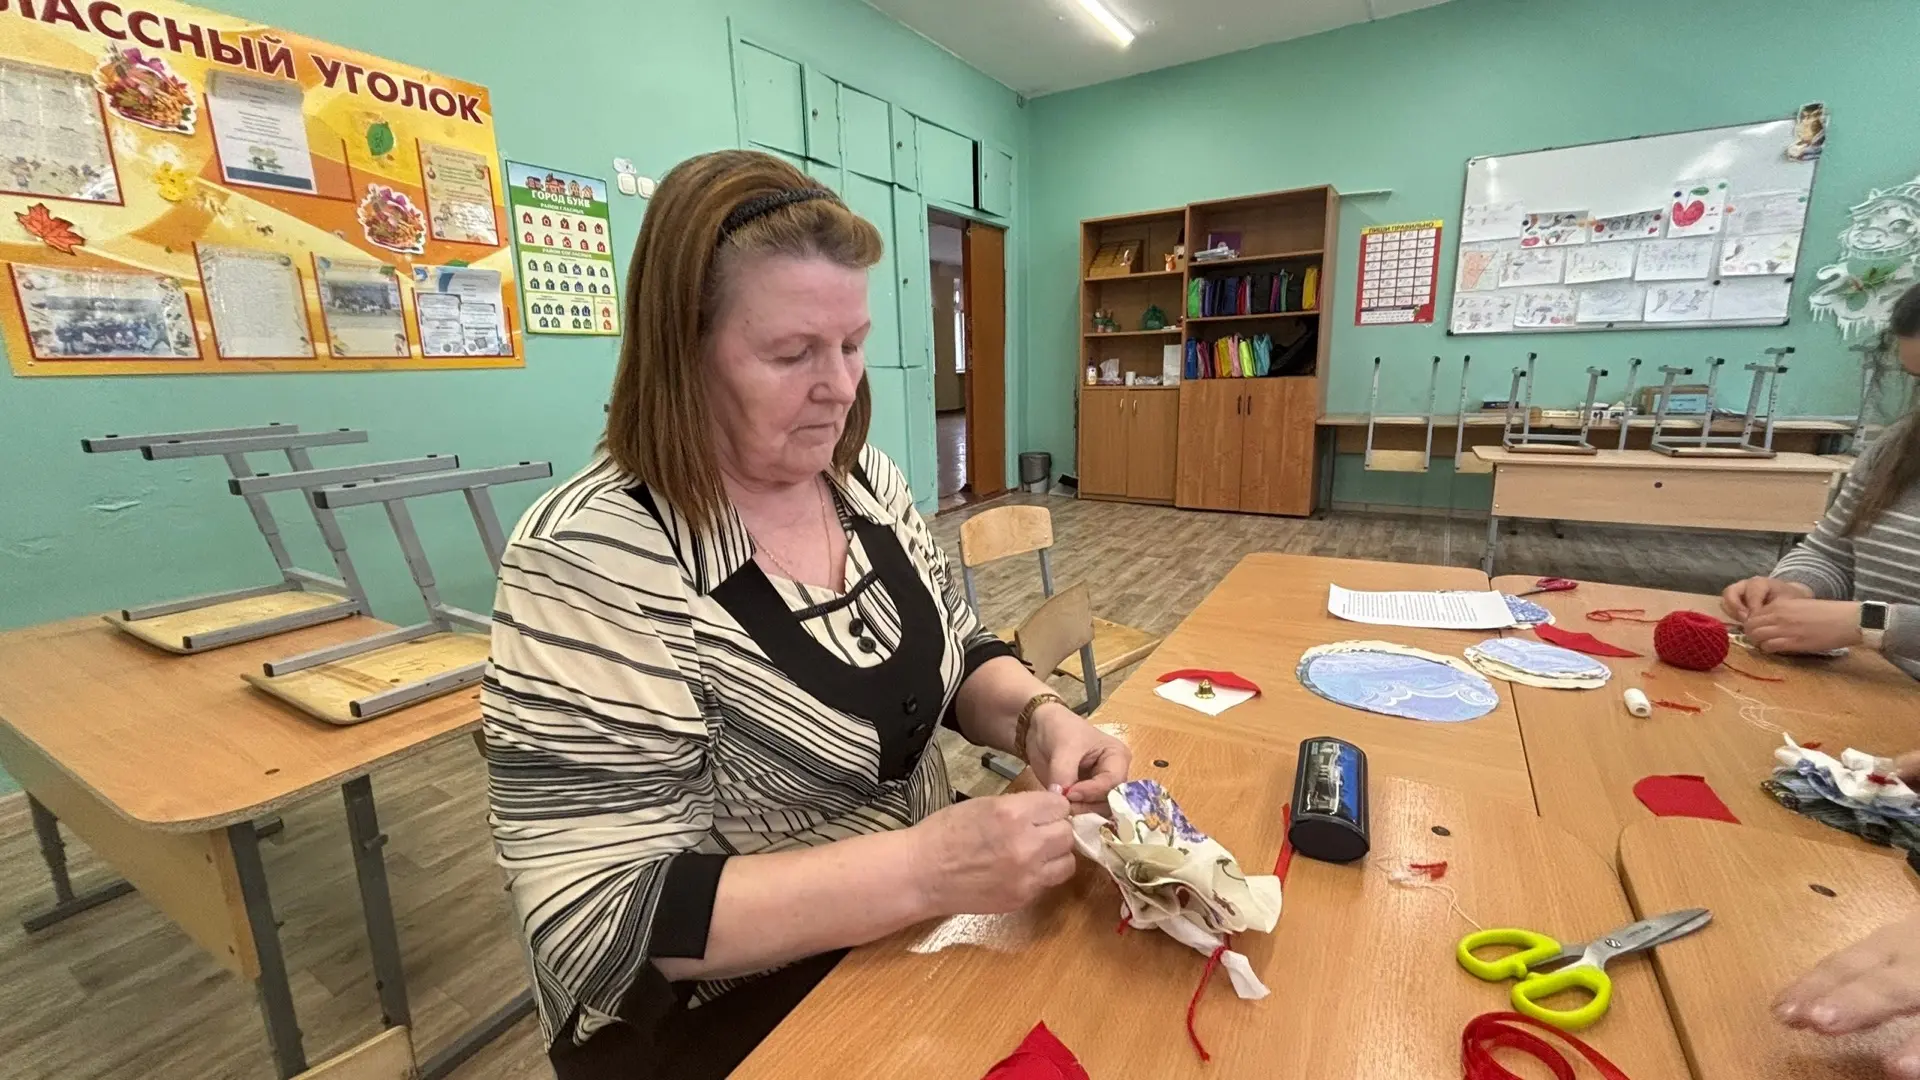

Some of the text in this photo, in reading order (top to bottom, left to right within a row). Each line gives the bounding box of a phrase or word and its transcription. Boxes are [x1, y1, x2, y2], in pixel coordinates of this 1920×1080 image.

[311, 55, 484, 125] УГОЛОК
[532, 190, 591, 208] ГОРОД БУКВ
